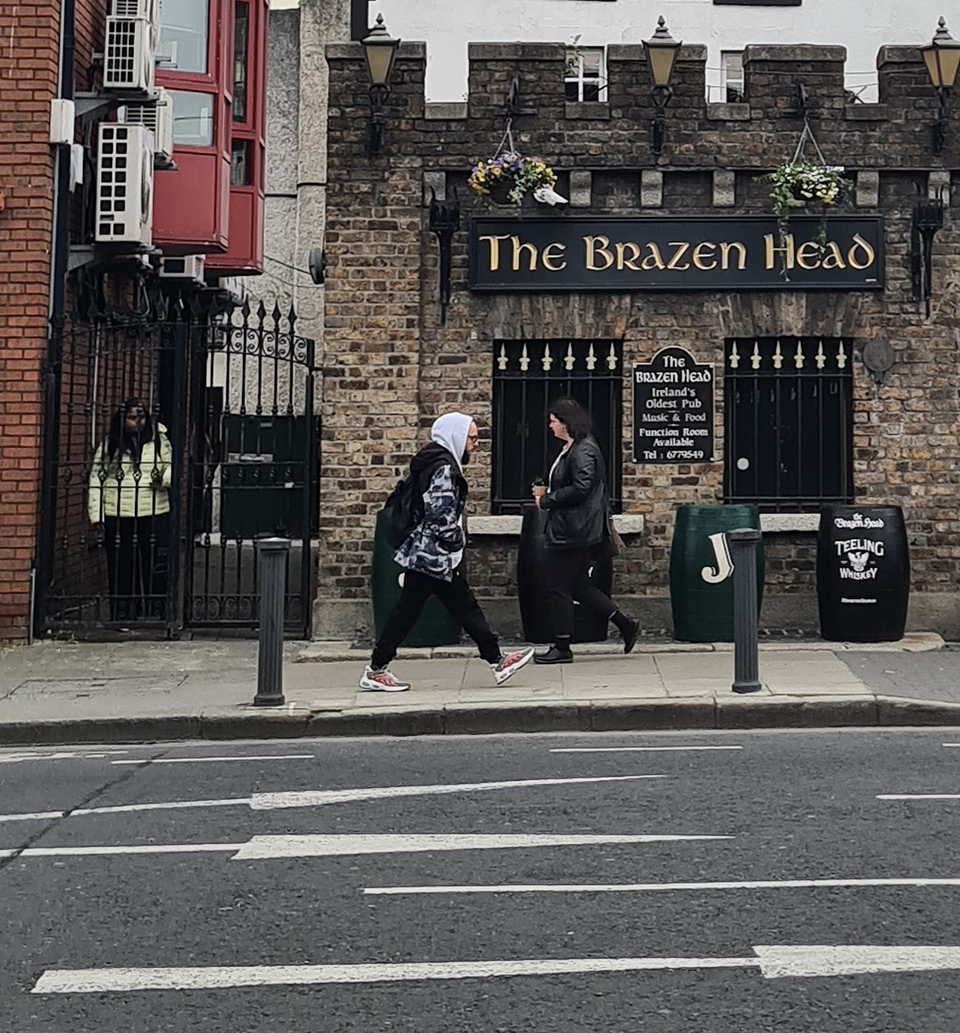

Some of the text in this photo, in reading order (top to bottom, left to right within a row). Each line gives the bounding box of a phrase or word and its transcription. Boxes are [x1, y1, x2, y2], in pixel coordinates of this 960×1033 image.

[479, 232, 876, 272] The Brazen Head
[663, 355, 686, 368] The
[635, 369, 711, 384] Brazen Head
[652, 387, 696, 398] Ireland's
[645, 398, 702, 409] Oldest Pub
[642, 412, 706, 422] Music & Food
[639, 427, 709, 437] Function Room
[653, 437, 695, 447] Available
[643, 450, 657, 459] Tel
[666, 450, 704, 459] 6779549
[834, 539, 884, 556] TEELING
[701, 532, 735, 584] J
[839, 567, 878, 580] WHISKEY
